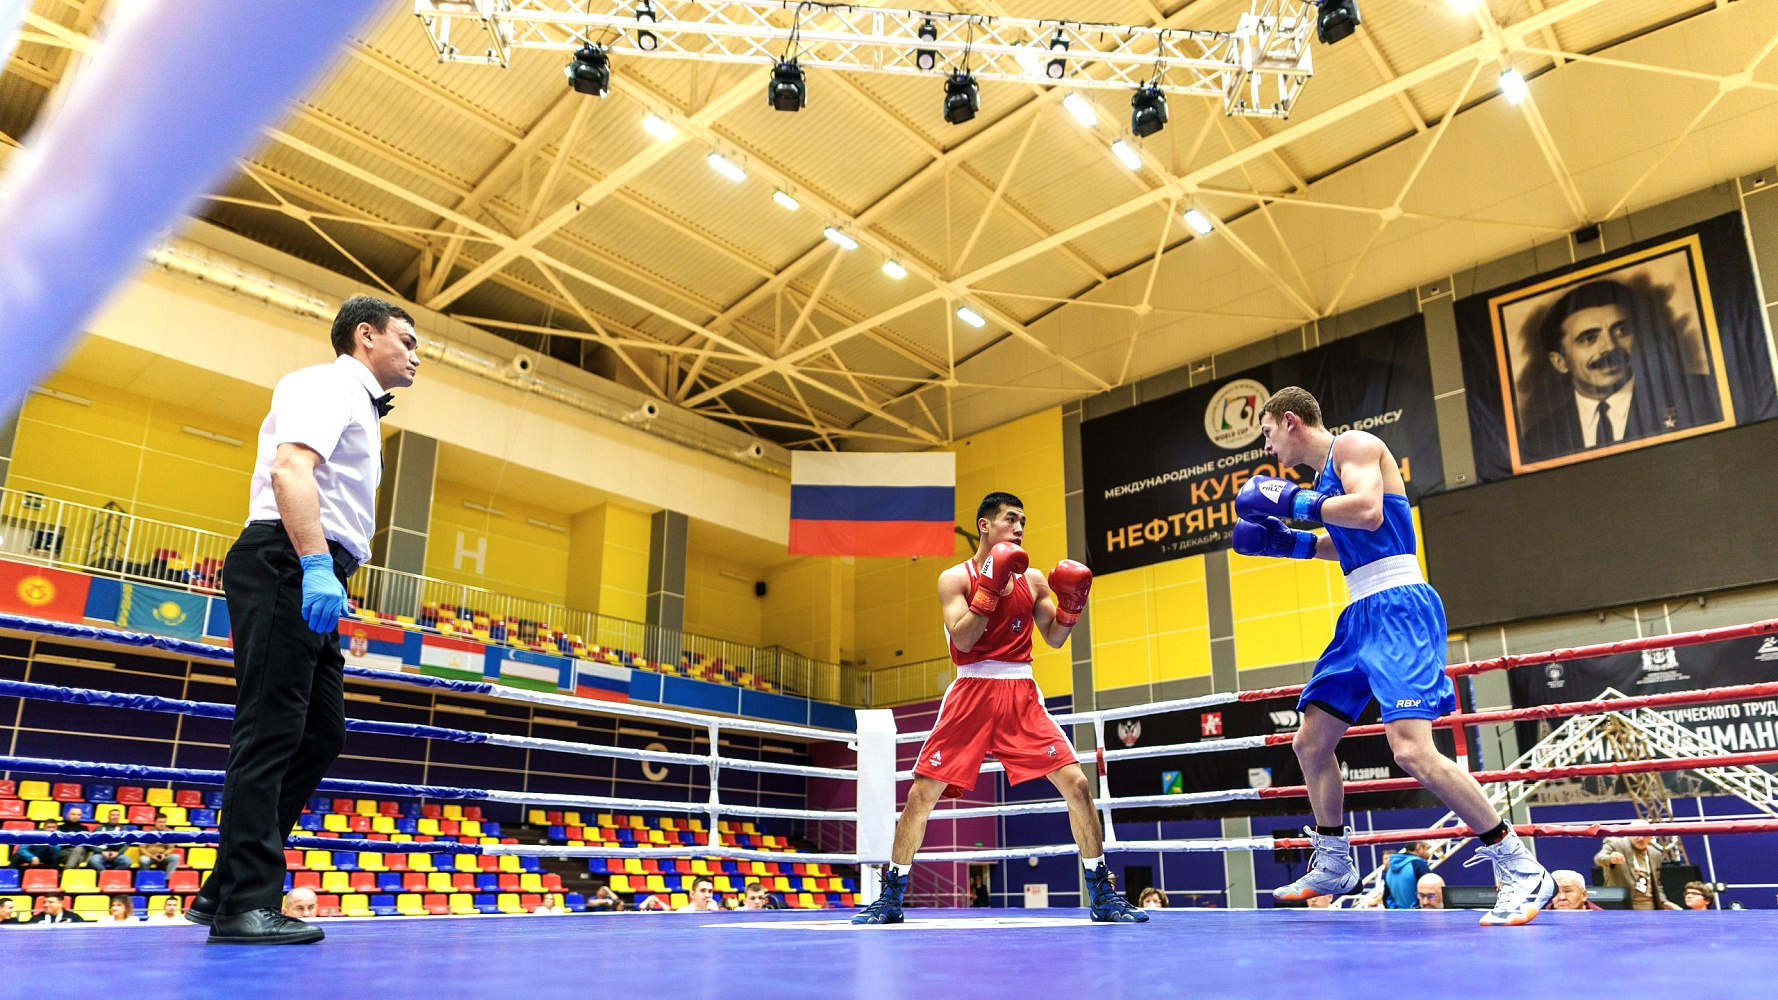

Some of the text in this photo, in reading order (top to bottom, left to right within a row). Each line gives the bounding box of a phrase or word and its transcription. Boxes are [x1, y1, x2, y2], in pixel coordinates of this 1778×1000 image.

[1104, 461, 1215, 499] МЕЖДУНАРОДНЫЕ
[1217, 447, 1274, 469] СОРЕВН
[1353, 408, 1403, 431] БОКСУ
[1106, 499, 1239, 553] НЕФТЯН
[1742, 700, 1778, 718] ТРУД
